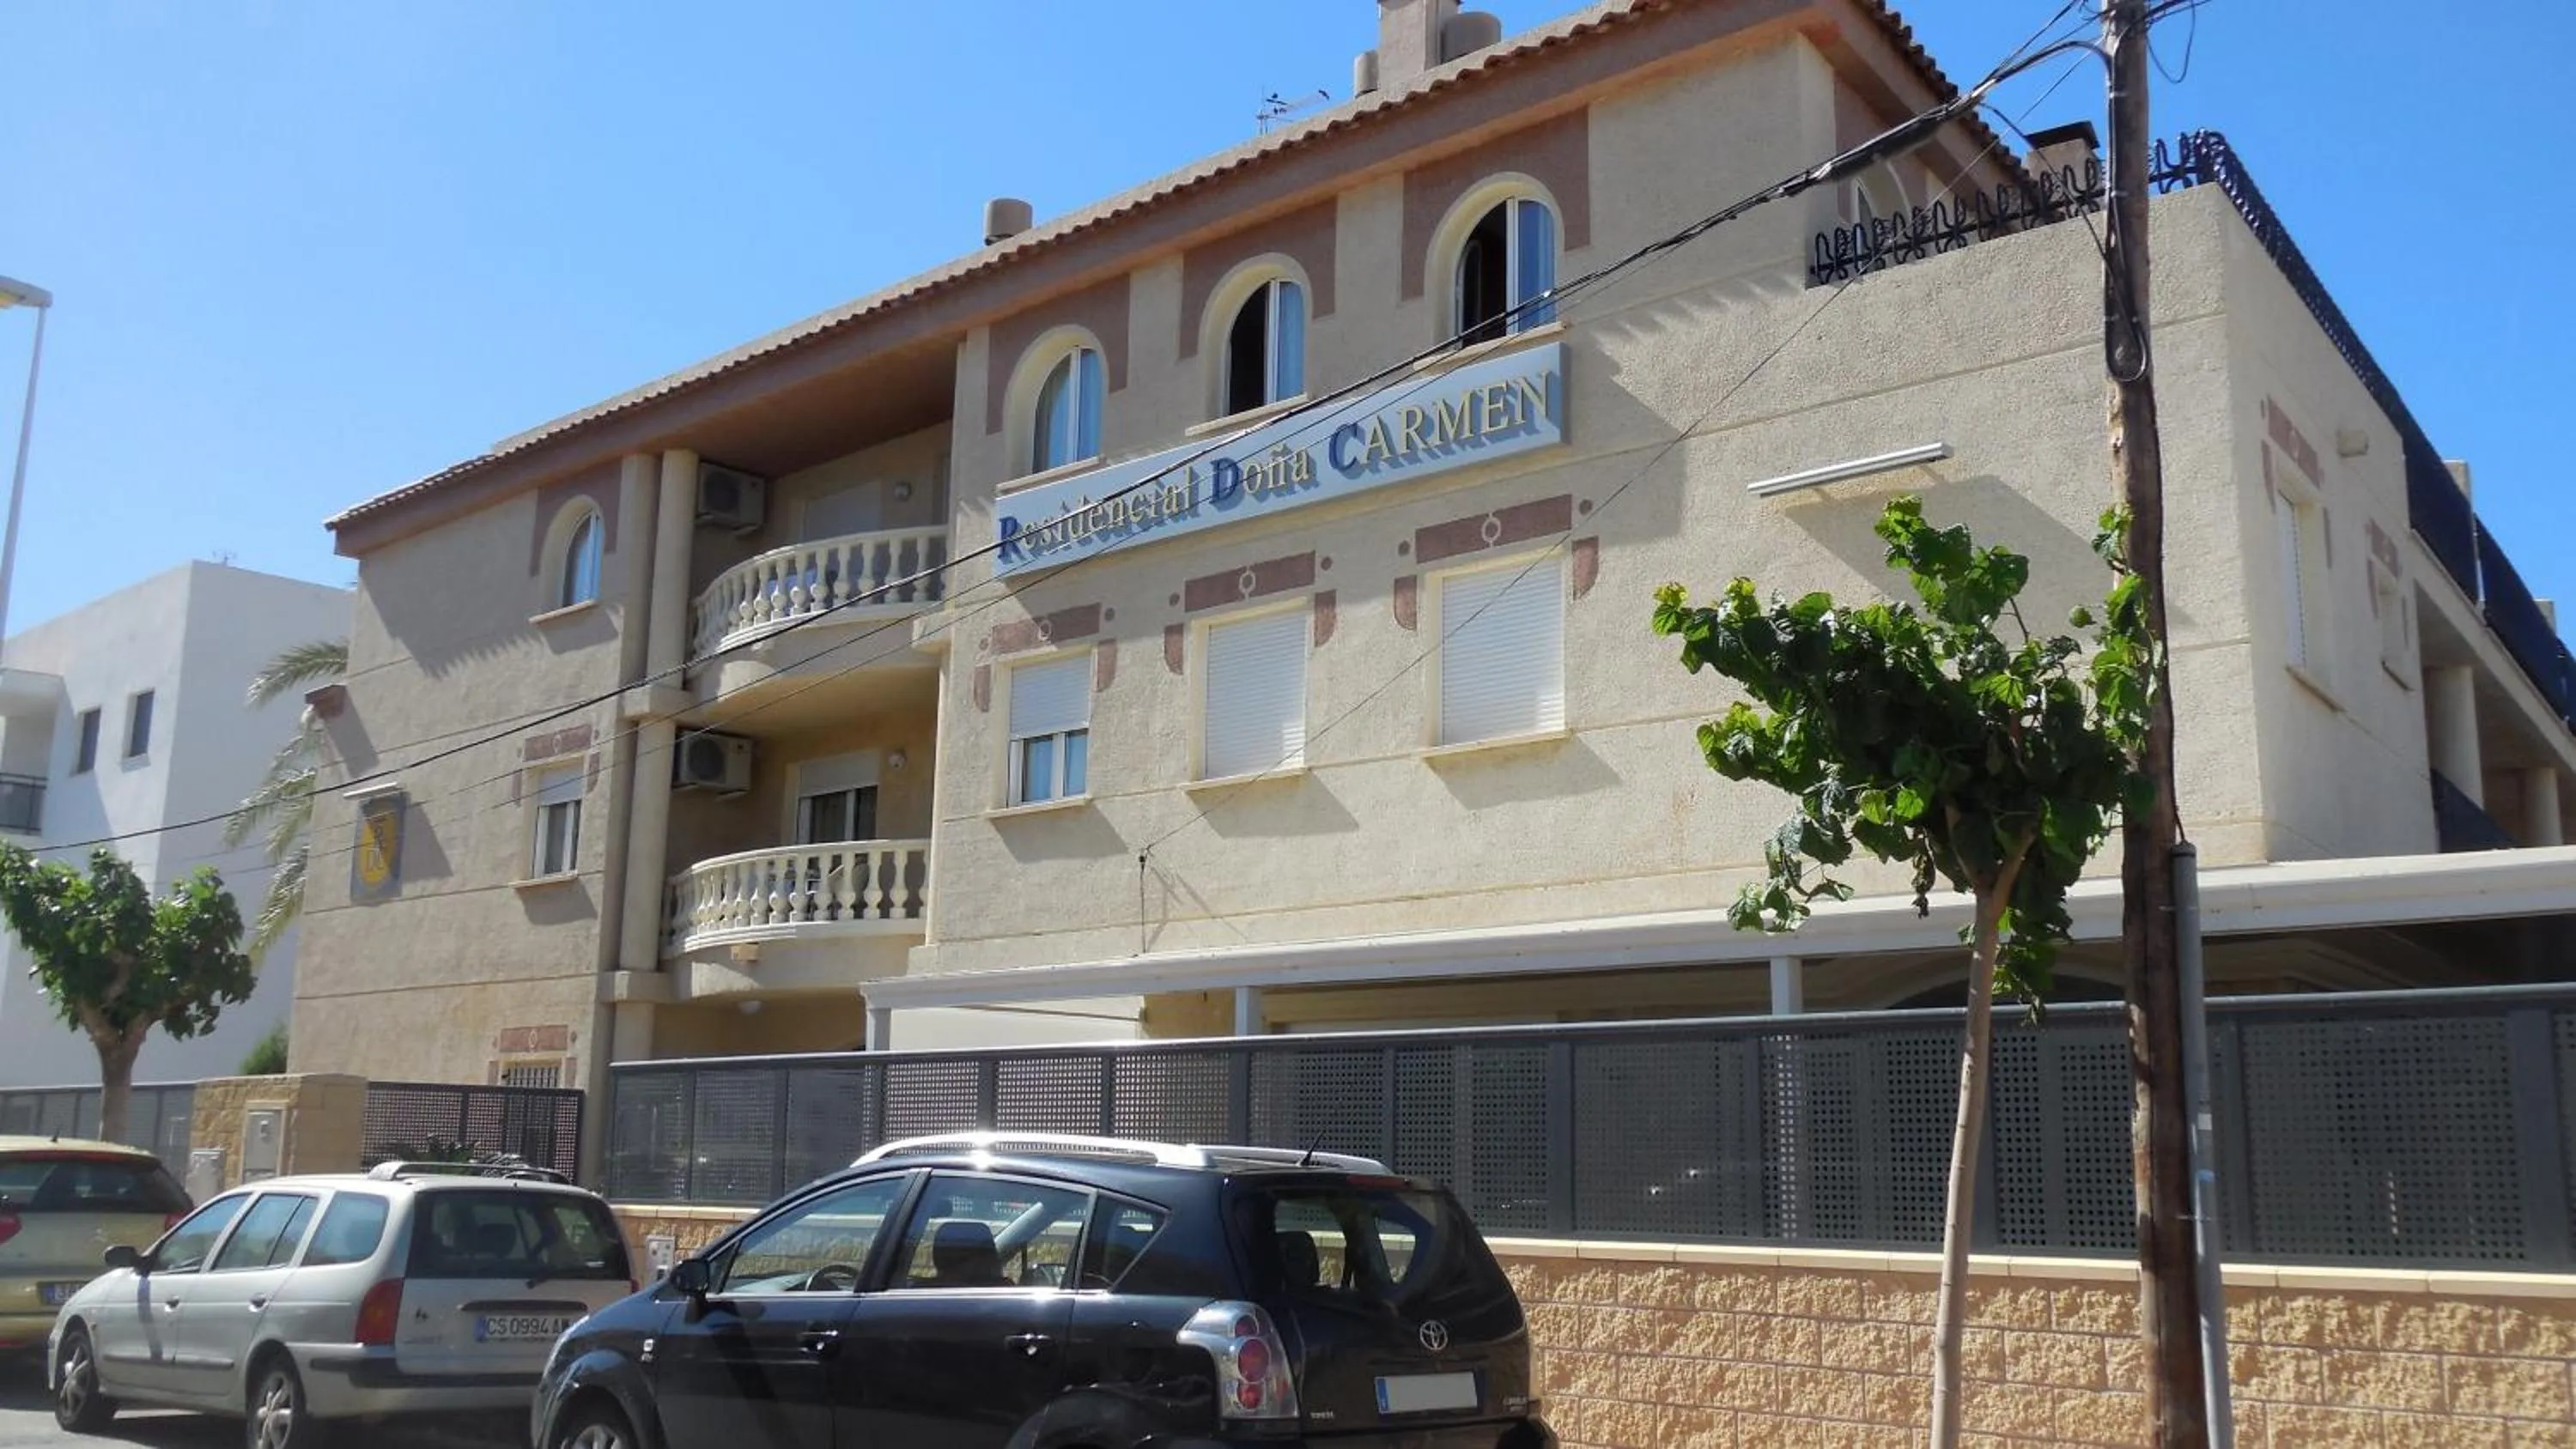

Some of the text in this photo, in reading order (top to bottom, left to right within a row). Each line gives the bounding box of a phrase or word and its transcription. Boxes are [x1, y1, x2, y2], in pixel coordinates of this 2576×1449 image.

[997, 369, 1556, 559] Residencial Doña CARMEN
[486, 1317, 507, 1335] CS
[509, 1317, 549, 1335] 0994
